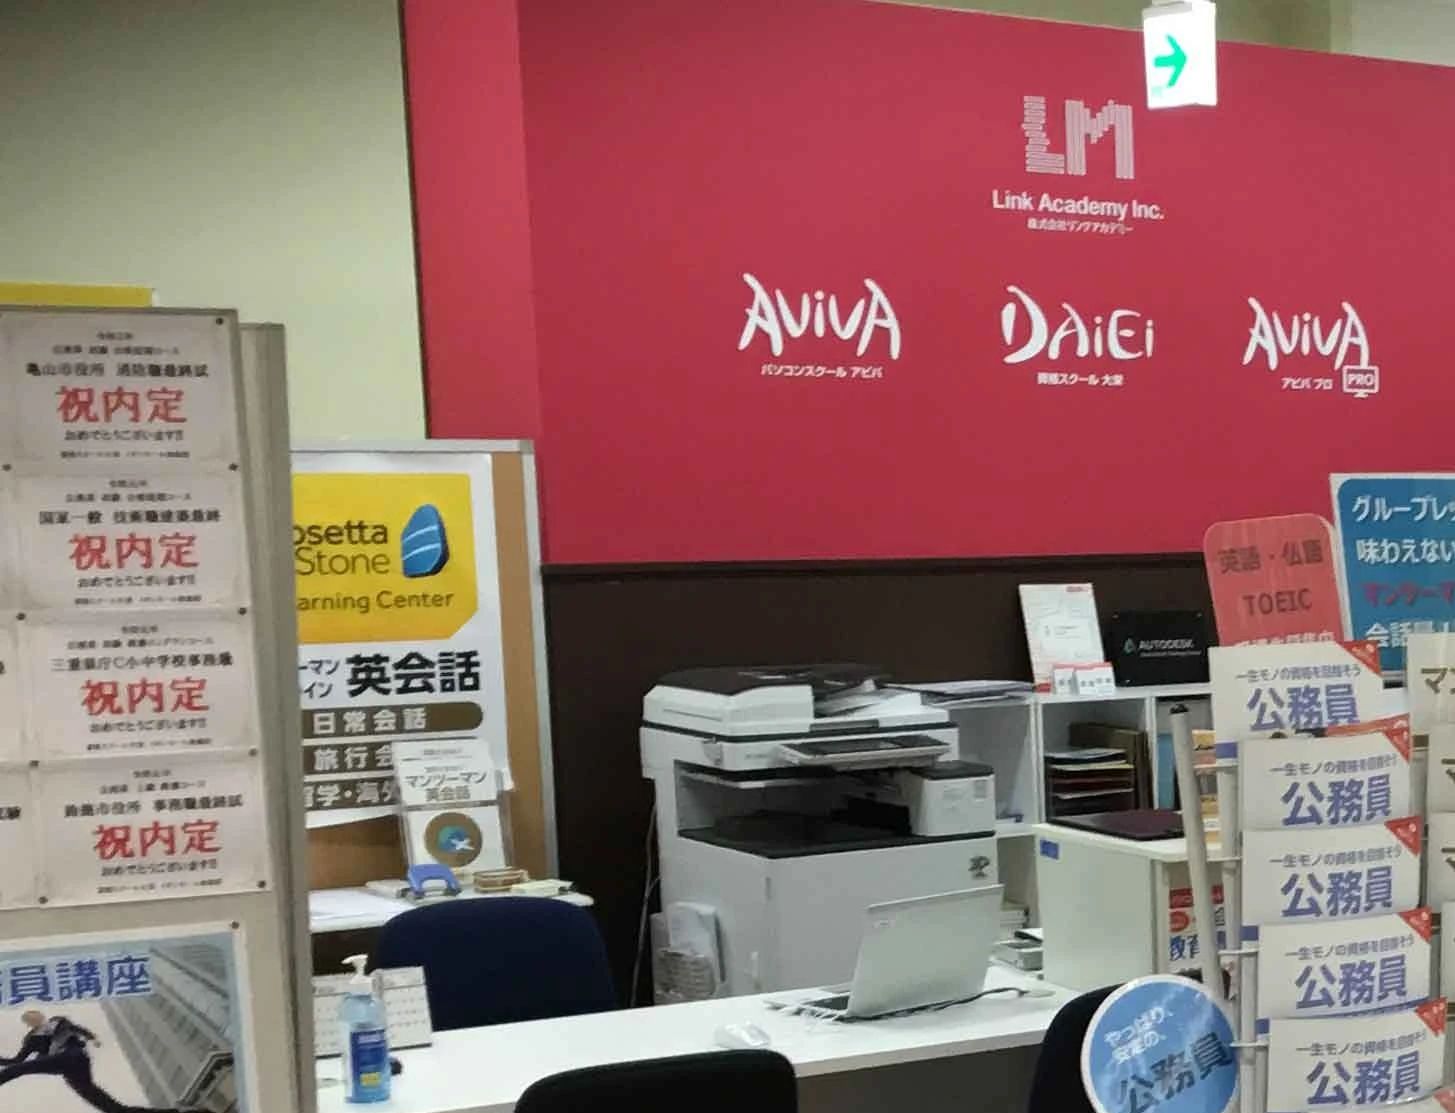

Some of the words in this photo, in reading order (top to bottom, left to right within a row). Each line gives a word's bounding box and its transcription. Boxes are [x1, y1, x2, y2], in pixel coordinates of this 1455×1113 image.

[991, 188, 1034, 211] Link
[1037, 192, 1128, 221] Academy
[1131, 199, 1166, 220] Inc.
[1346, 373, 1374, 388] PRO
[55, 385, 188, 425] 祝内定
[68, 532, 200, 571] 祝内定
[296, 546, 391, 576] Stone
[376, 590, 455, 609] Center
[1242, 588, 1313, 617] TOEIC
[300, 682, 333, 699] イン
[346, 651, 482, 697] 英会話
[80, 676, 210, 716] 祝内定
[1247, 683, 1360, 733] 公務員
[312, 707, 427, 734] 日常会話
[404, 770, 487, 790] マンツーマン
[1281, 773, 1392, 827] 公務員
[92, 819, 223, 860] 祝内定
[1280, 865, 1393, 919] 公務員
[0, 953, 153, 1005] 員講座
[1294, 954, 1407, 1011] 公務員
[1306, 1050, 1420, 1106] 公務員
